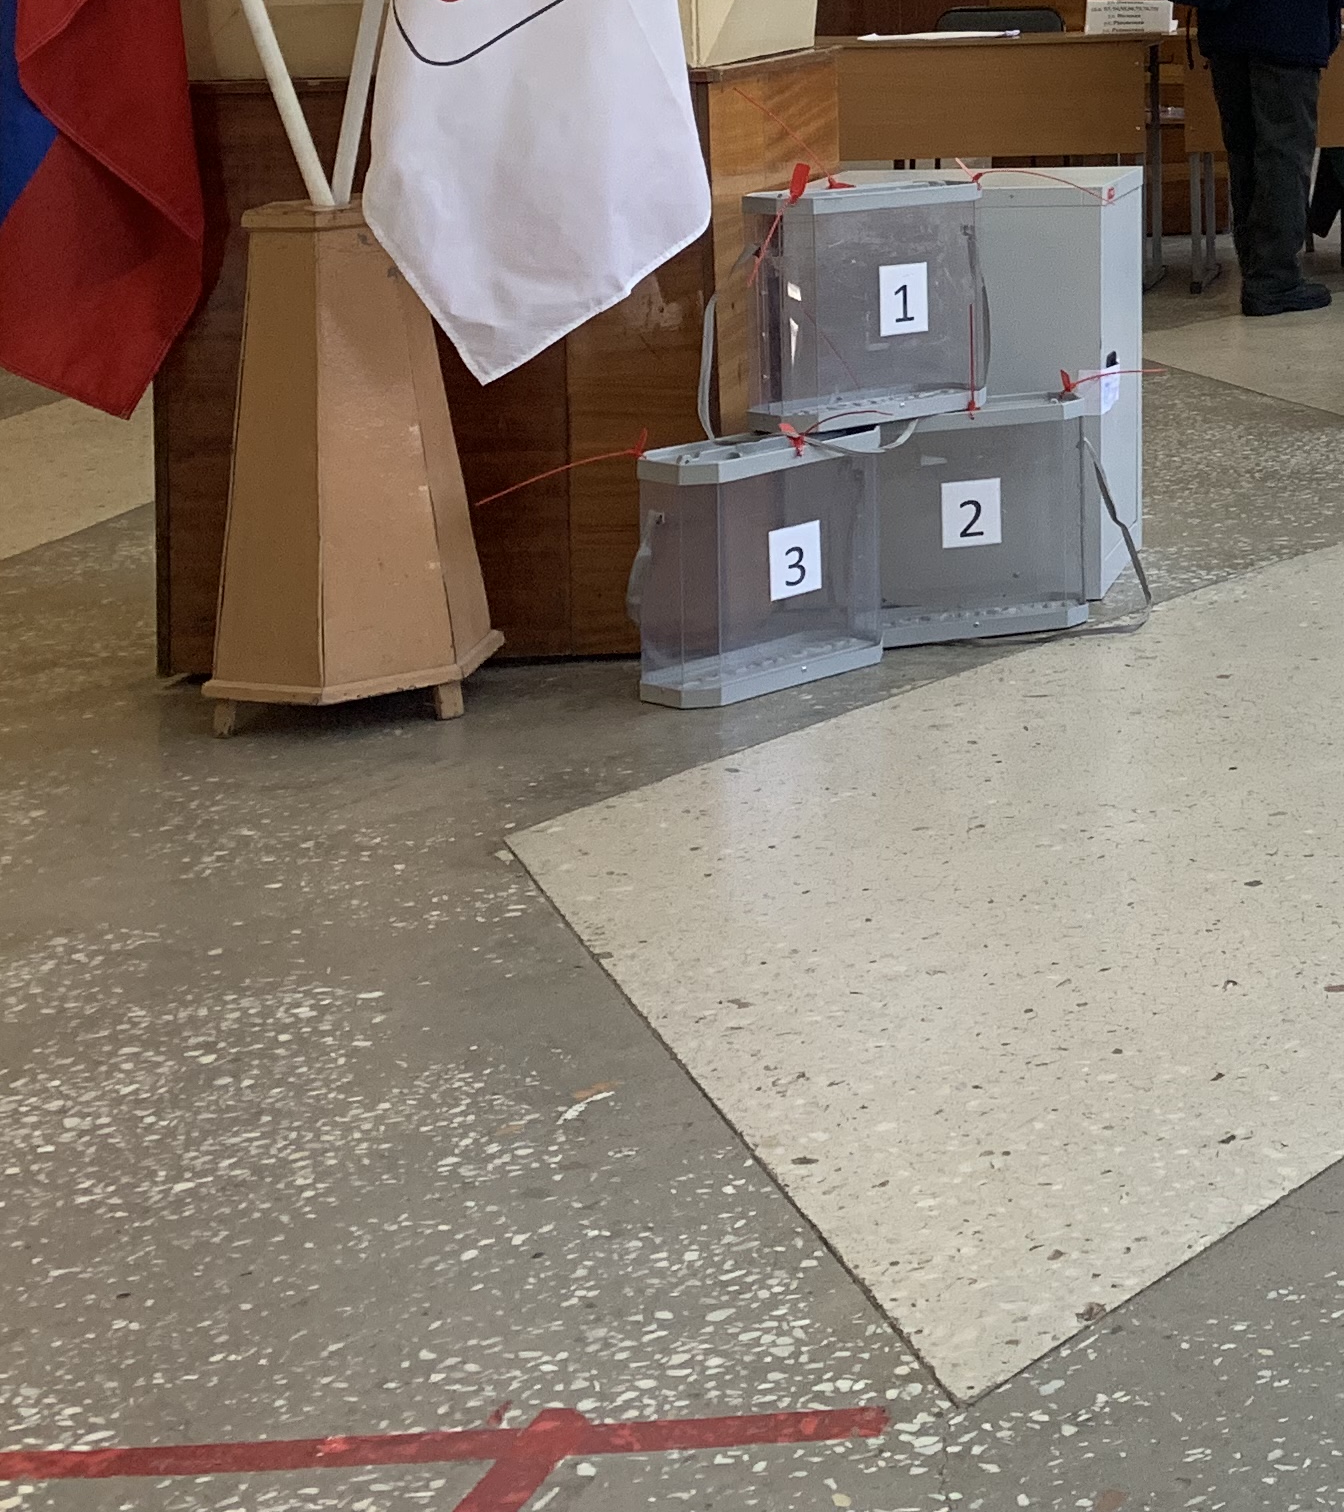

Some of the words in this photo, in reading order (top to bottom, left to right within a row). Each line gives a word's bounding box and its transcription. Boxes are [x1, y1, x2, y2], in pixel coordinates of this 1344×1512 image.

[894, 284, 915, 323] 1
[959, 499, 984, 538] 2
[785, 546, 806, 586] 3
